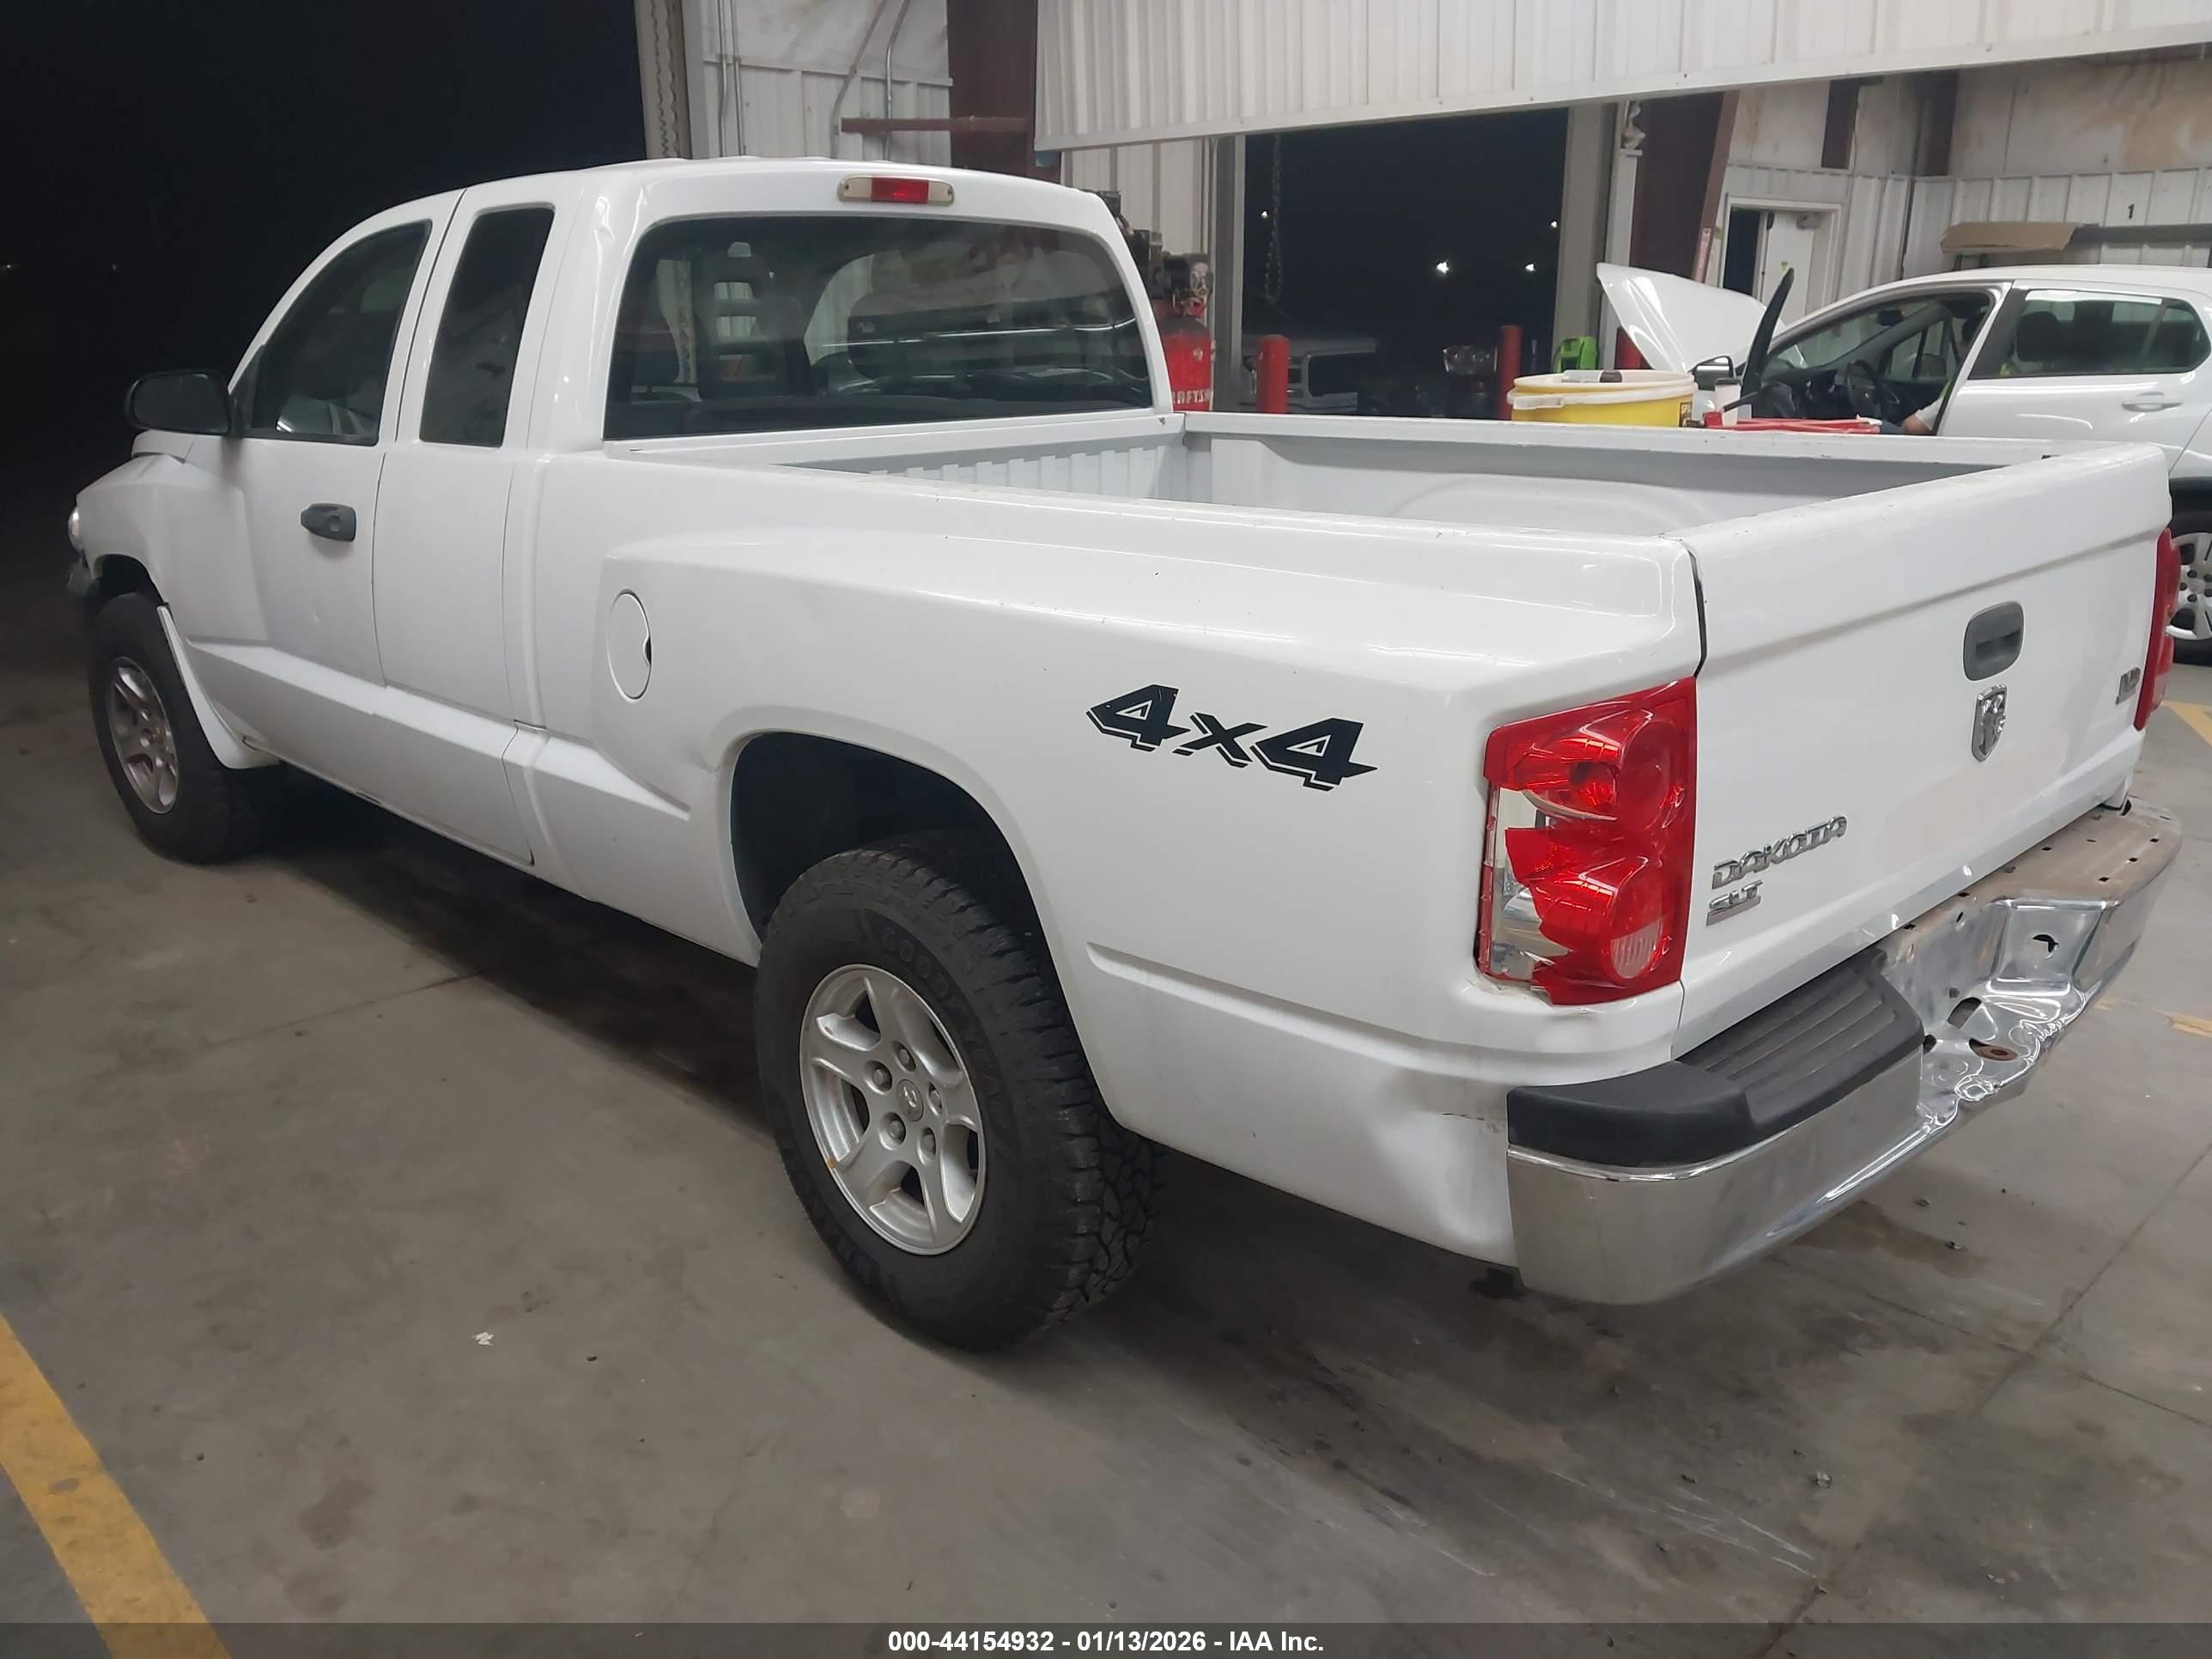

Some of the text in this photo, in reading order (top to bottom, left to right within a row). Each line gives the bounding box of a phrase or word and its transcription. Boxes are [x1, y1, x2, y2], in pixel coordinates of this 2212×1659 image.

[2128, 203, 2135, 219] 1
[1086, 684, 1377, 791] 4x4
[1711, 816, 1848, 890] DAKOTA
